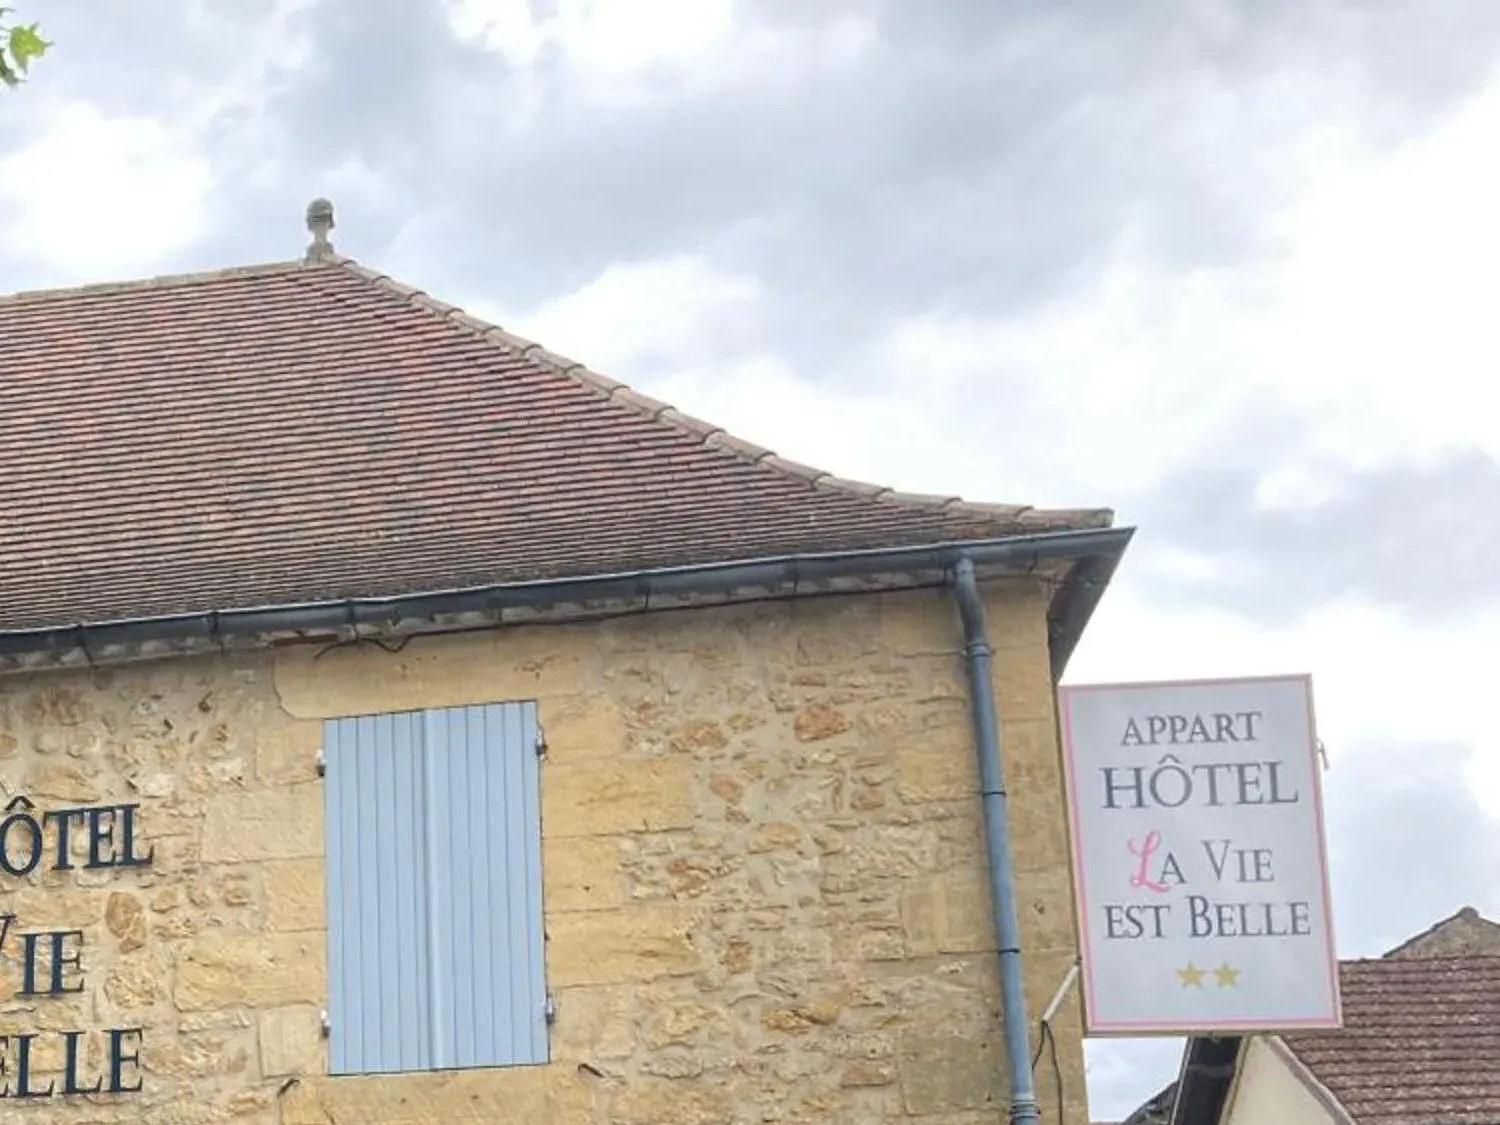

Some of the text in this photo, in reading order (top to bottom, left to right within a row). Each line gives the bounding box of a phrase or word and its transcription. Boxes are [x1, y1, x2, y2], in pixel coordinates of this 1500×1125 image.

[1120, 711, 1262, 746] APPART
[1098, 754, 1300, 809] HÔTEL
[1200, 839, 1275, 884] VIE
[1102, 895, 1312, 939] EST BELLE
